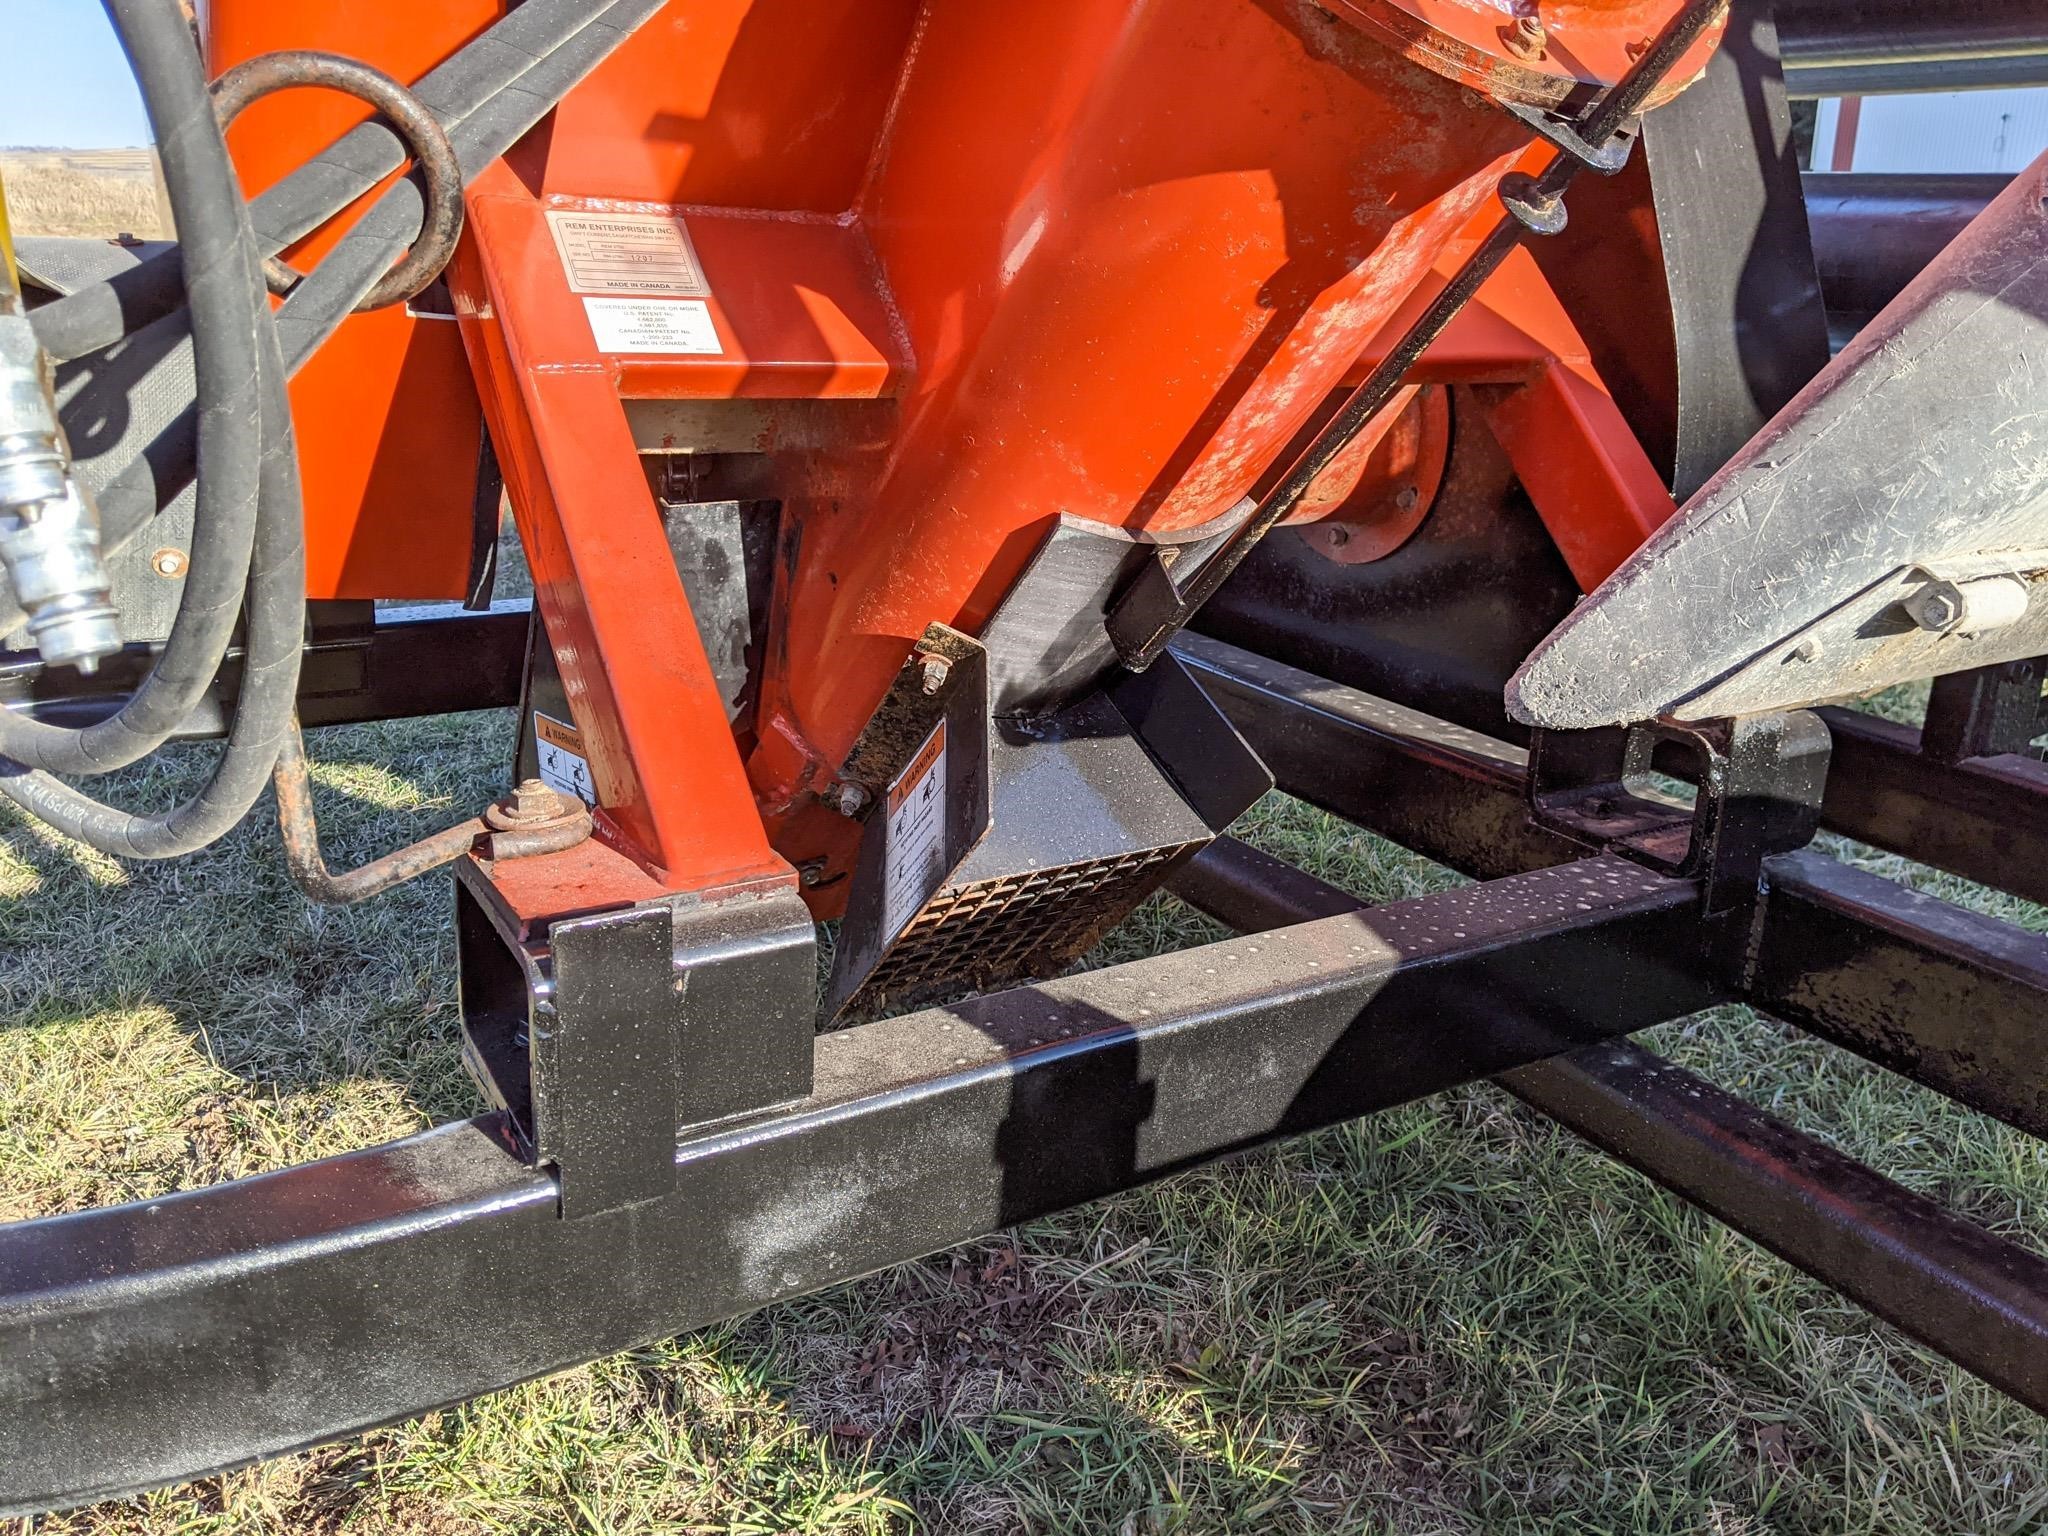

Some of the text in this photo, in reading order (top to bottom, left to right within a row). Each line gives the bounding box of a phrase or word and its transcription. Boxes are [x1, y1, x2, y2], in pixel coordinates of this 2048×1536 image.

[565, 222, 676, 236] REM ENTERPRISES INC.
[551, 728, 581, 751] WARNING
[904, 742, 937, 791] WARNING
